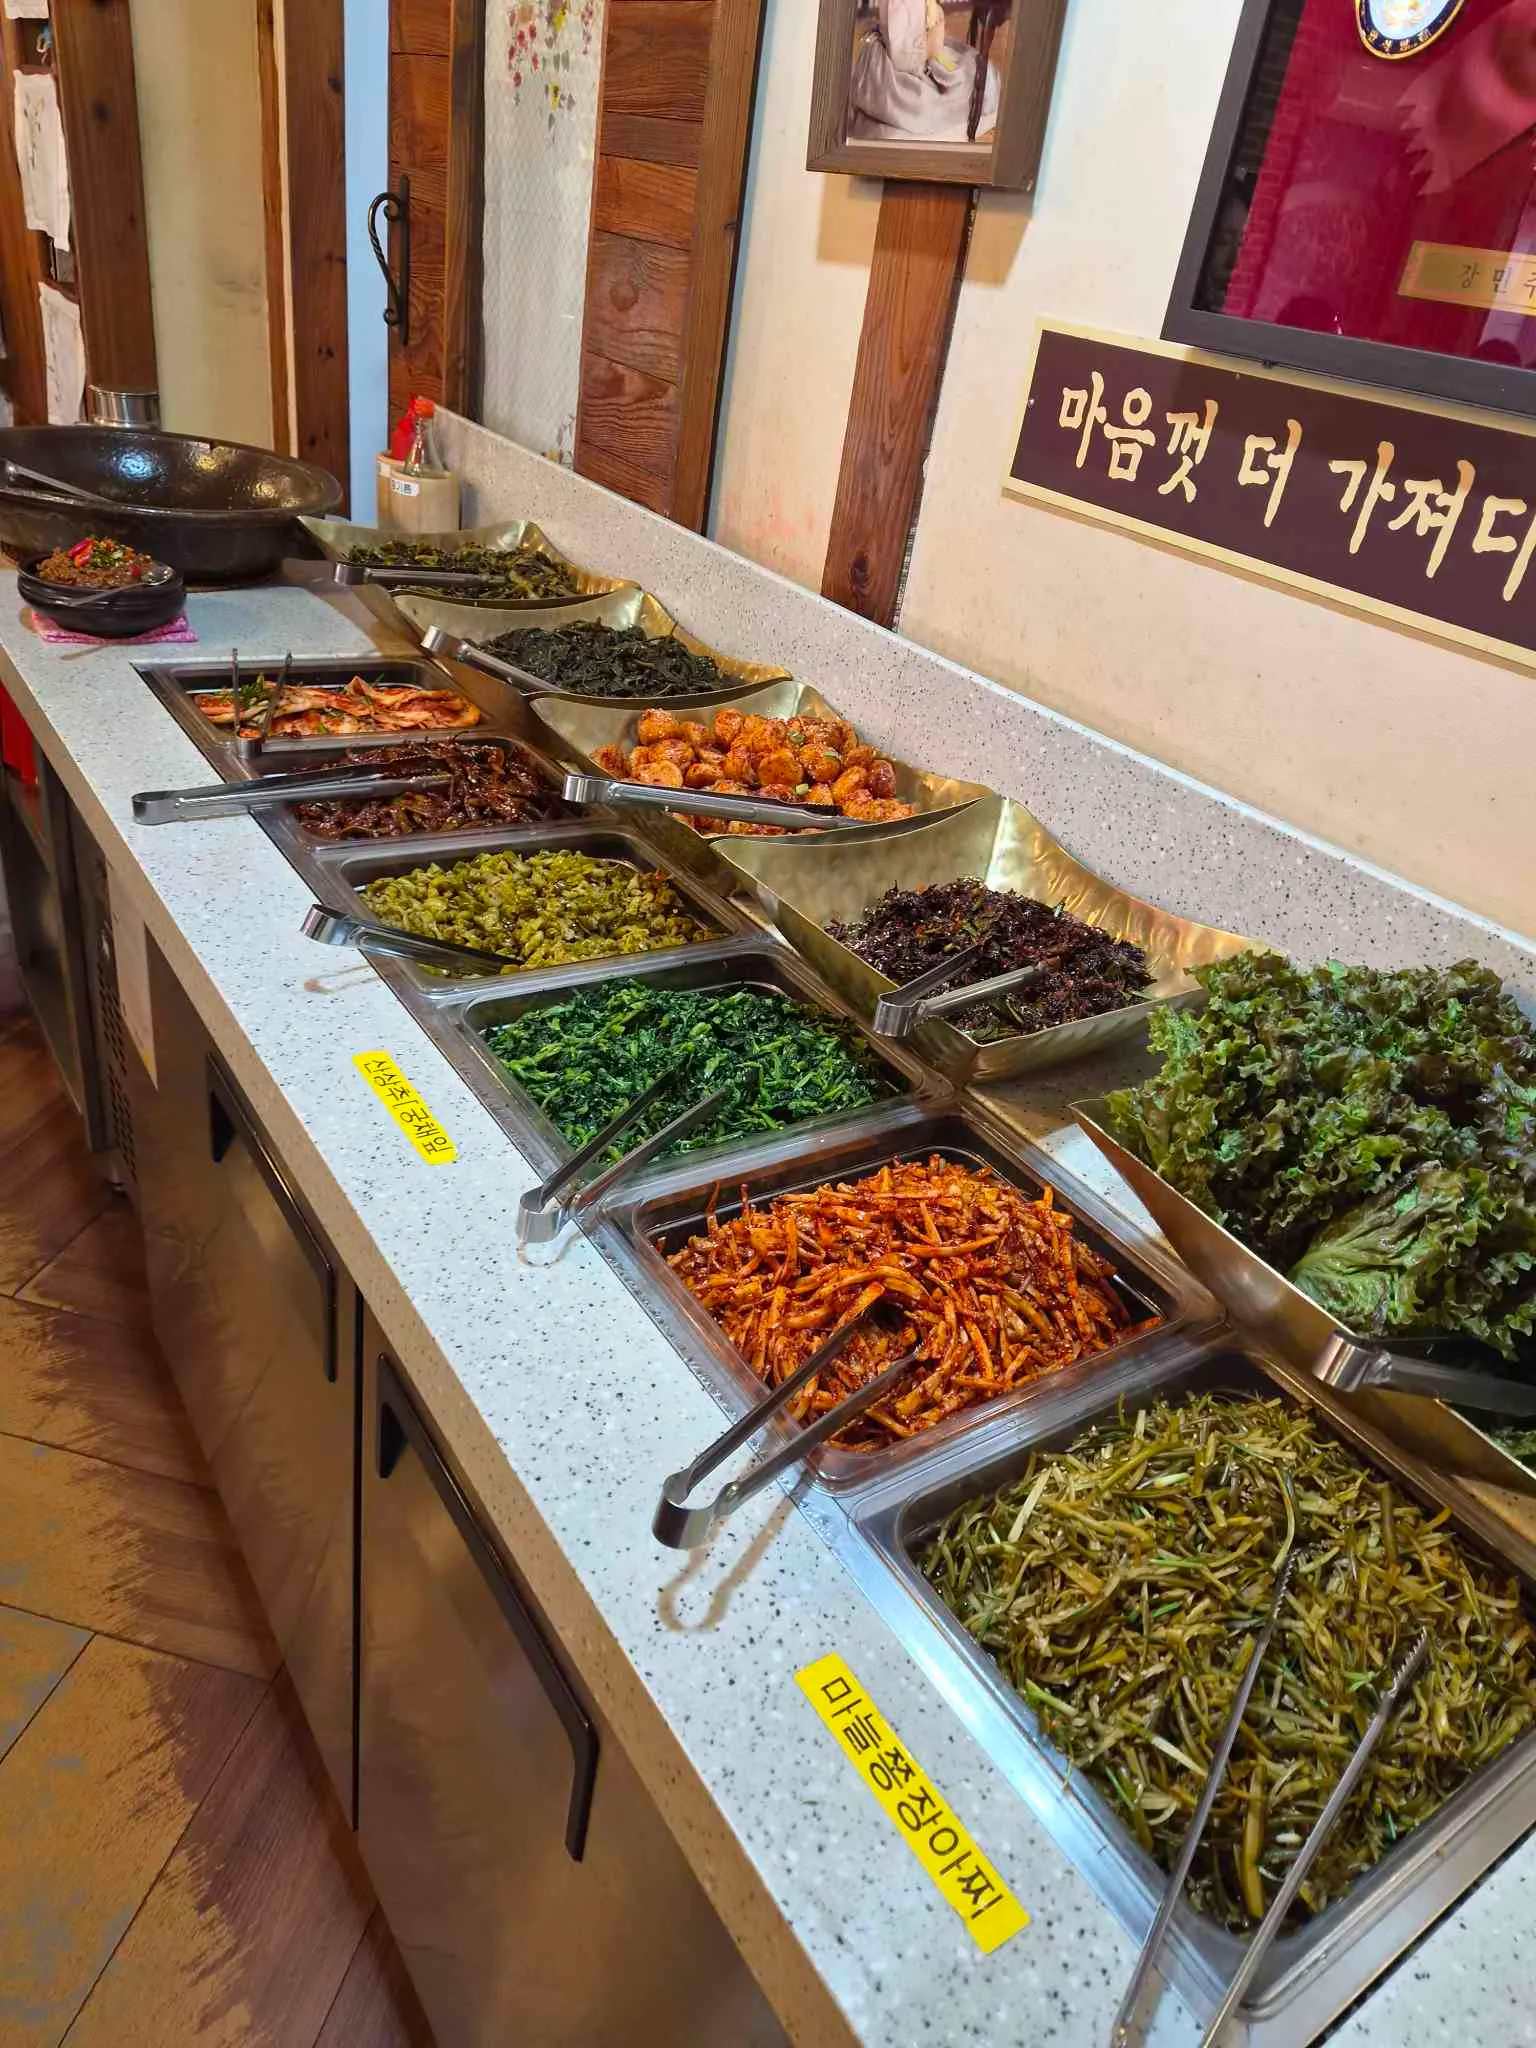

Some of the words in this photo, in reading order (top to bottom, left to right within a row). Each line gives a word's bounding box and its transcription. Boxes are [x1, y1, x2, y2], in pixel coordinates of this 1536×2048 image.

[1058, 371, 1219, 502] 마음껏
[1237, 419, 1303, 527] 더
[820, 1676, 1003, 1920] 마늘쫑장아찌
